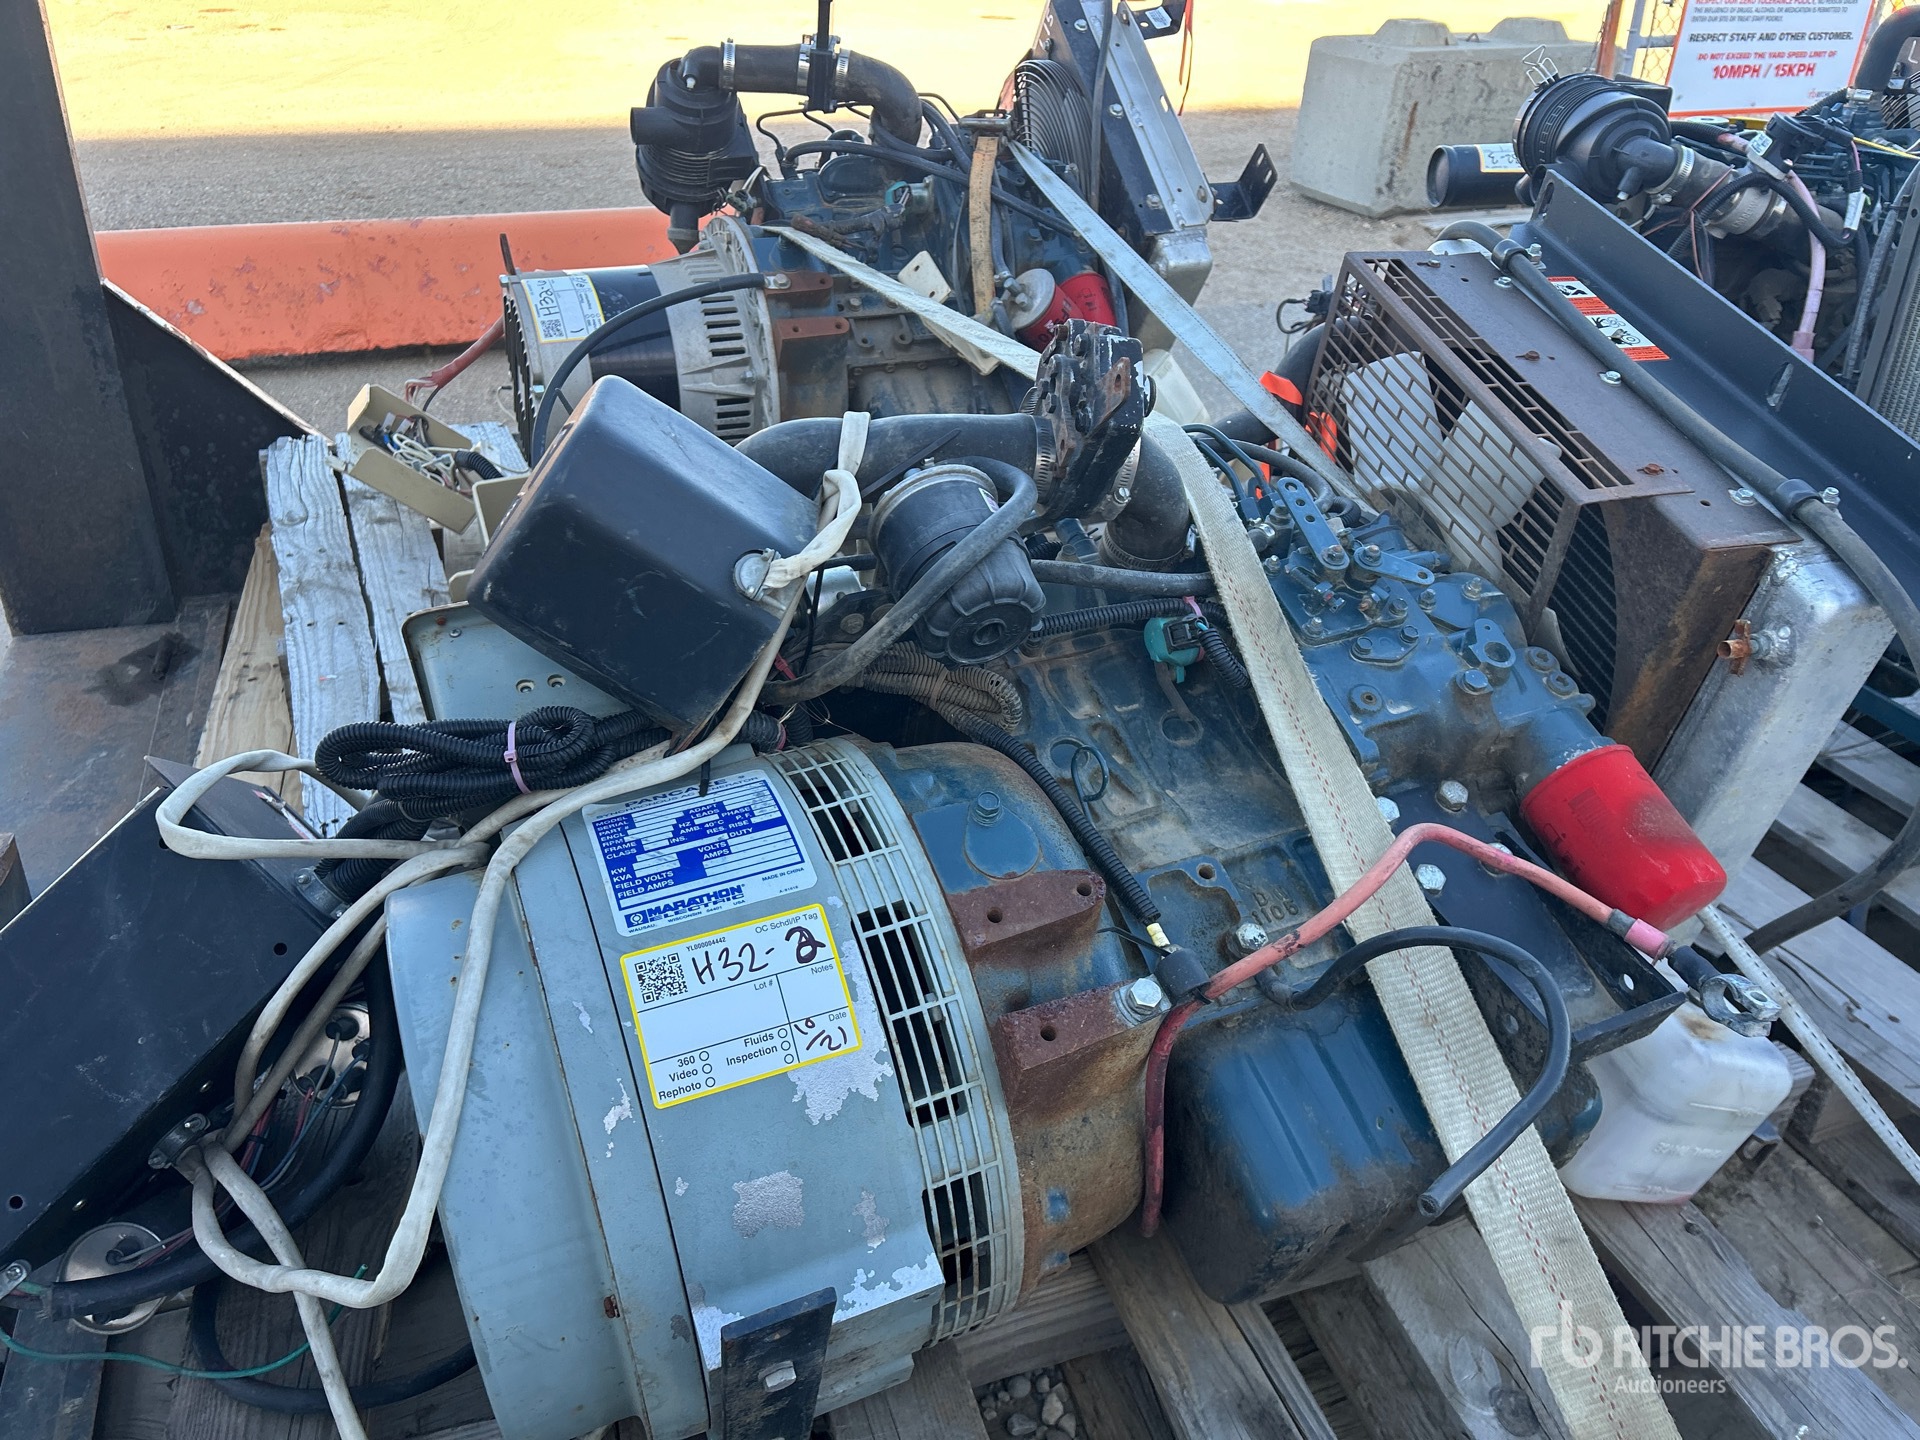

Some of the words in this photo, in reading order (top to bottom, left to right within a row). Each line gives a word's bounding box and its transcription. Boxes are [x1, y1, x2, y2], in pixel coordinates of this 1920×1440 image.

[1688, 32, 1729, 42] RESPECT
[1729, 32, 1757, 42] STAFF
[1758, 32, 1777, 42] AND
[1778, 31, 1807, 41] OTHER
[1808, 31, 1854, 41] CUSTOMER.
[1725, 52, 1751, 60] EXCEED
[1754, 52, 1766, 60] THE
[1786, 51, 1808, 59] SPEED
[1712, 64, 1762, 79] 10MPH
[1763, 63, 1773, 79] /
[1774, 63, 1817, 78] 15KPH
[624, 779, 727, 808] PANCAE
[688, 803, 718, 815] ADAPT
[690, 808, 721, 820] LEADS
[721, 806, 751, 819] PHASE
[595, 815, 629, 828] MODEL
[596, 821, 630, 832] SERIAL
[678, 820, 692, 829] HZ
[706, 826, 727, 836] RES.
[728, 818, 751, 830] RISE
[599, 827, 621, 837] PART
[679, 825, 703, 836] AMB.
[729, 827, 754, 839] DUTY
[600, 832, 626, 843] ENCL
[602, 837, 625, 848] RPM
[603, 841, 637, 854] FRAME
[605, 847, 638, 861] CLASS
[697, 841, 728, 854] VOLTS
[702, 848, 731, 861] AMPS
[610, 866, 627, 876] KW
[761, 873, 779, 882] MADE
[786, 867, 805, 876] CHINA
[612, 873, 633, 883] KVA
[615, 878, 642, 891] FIELD
[643, 870, 675, 884] VOLTS
[617, 886, 645, 900] FIELD
[647, 879, 675, 892] AMPS
[647, 883, 744, 918] MARATHON
[648, 893, 745, 923] ELECTRIC
[667, 911, 703, 924] WISCONSIN
[732, 899, 747, 907] USA
[1251, 899, 1300, 926] 1105
[754, 924, 769, 934] OC
[802, 911, 819, 922] Tag
[810, 963, 834, 976] Notes
[753, 981, 768, 992] Lot
[828, 1010, 848, 1023] Date
[743, 1031, 775, 1048] Fluids
[725, 1043, 778, 1067] Inspection
[676, 1055, 696, 1069] 360
[668, 1067, 699, 1083] Video
[658, 1080, 702, 1101] Rephoto
